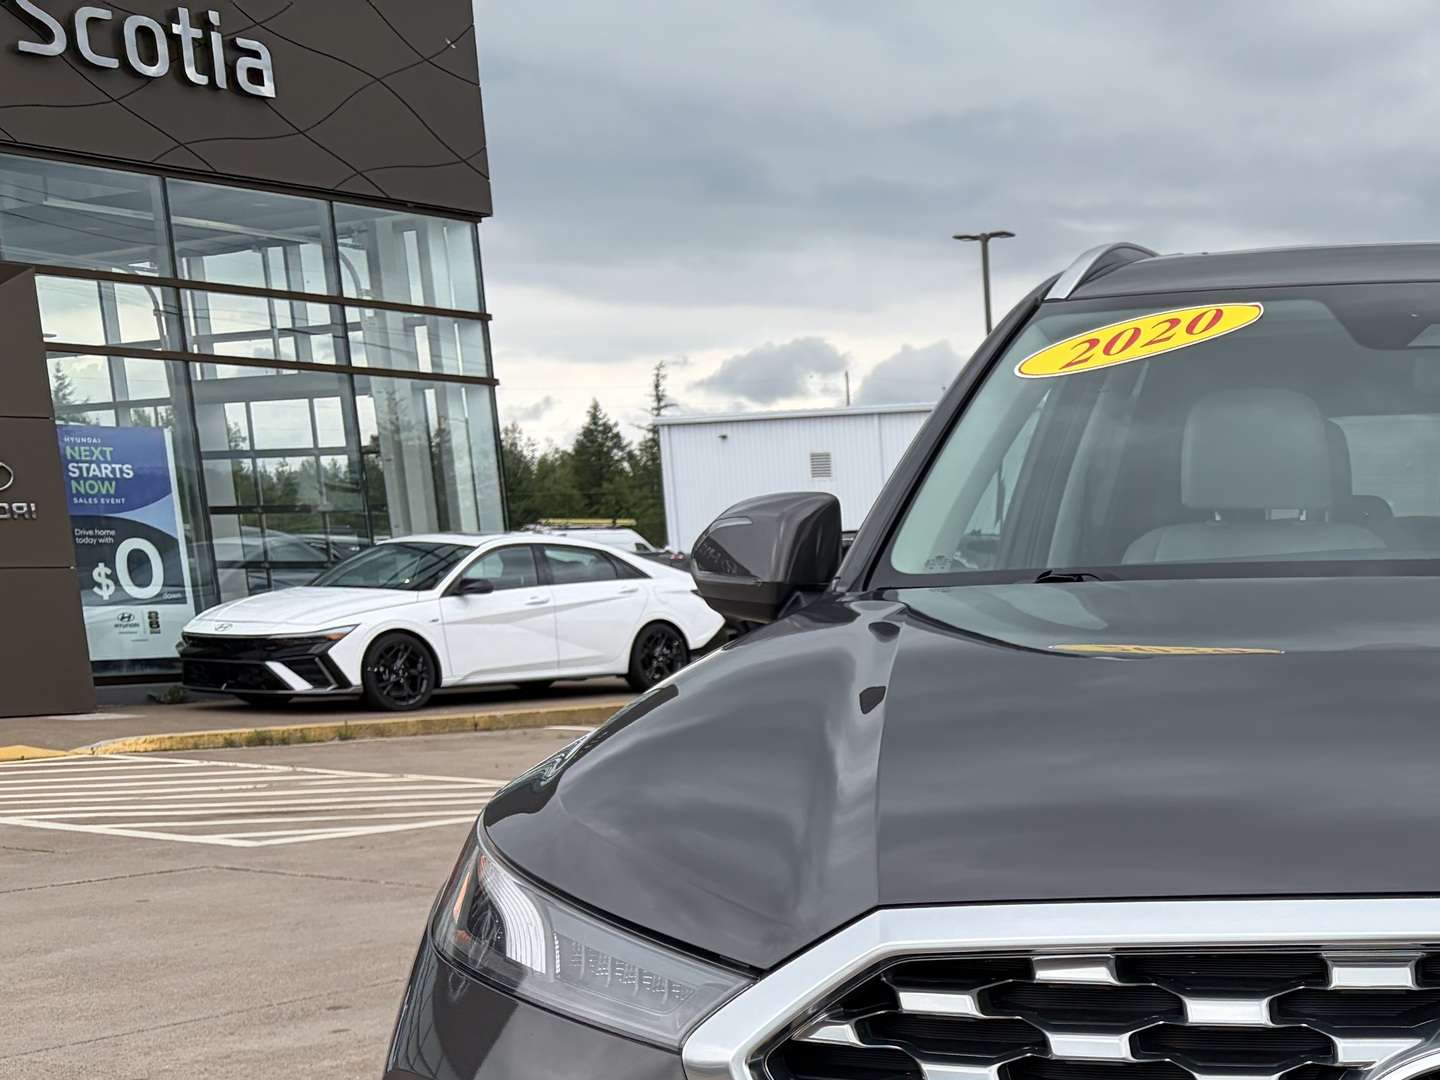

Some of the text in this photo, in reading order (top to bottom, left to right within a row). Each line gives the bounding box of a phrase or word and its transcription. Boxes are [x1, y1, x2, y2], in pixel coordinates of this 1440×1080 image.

[16, 0, 276, 98] Scotia
[1059, 308, 1224, 370] 2020
[65, 446, 113, 461] NEXT
[68, 463, 134, 479] STARTS
[71, 480, 116, 495] NOW
[74, 528, 94, 536] Drive
[75, 536, 97, 545] today
[92, 538, 164, 600] $0
